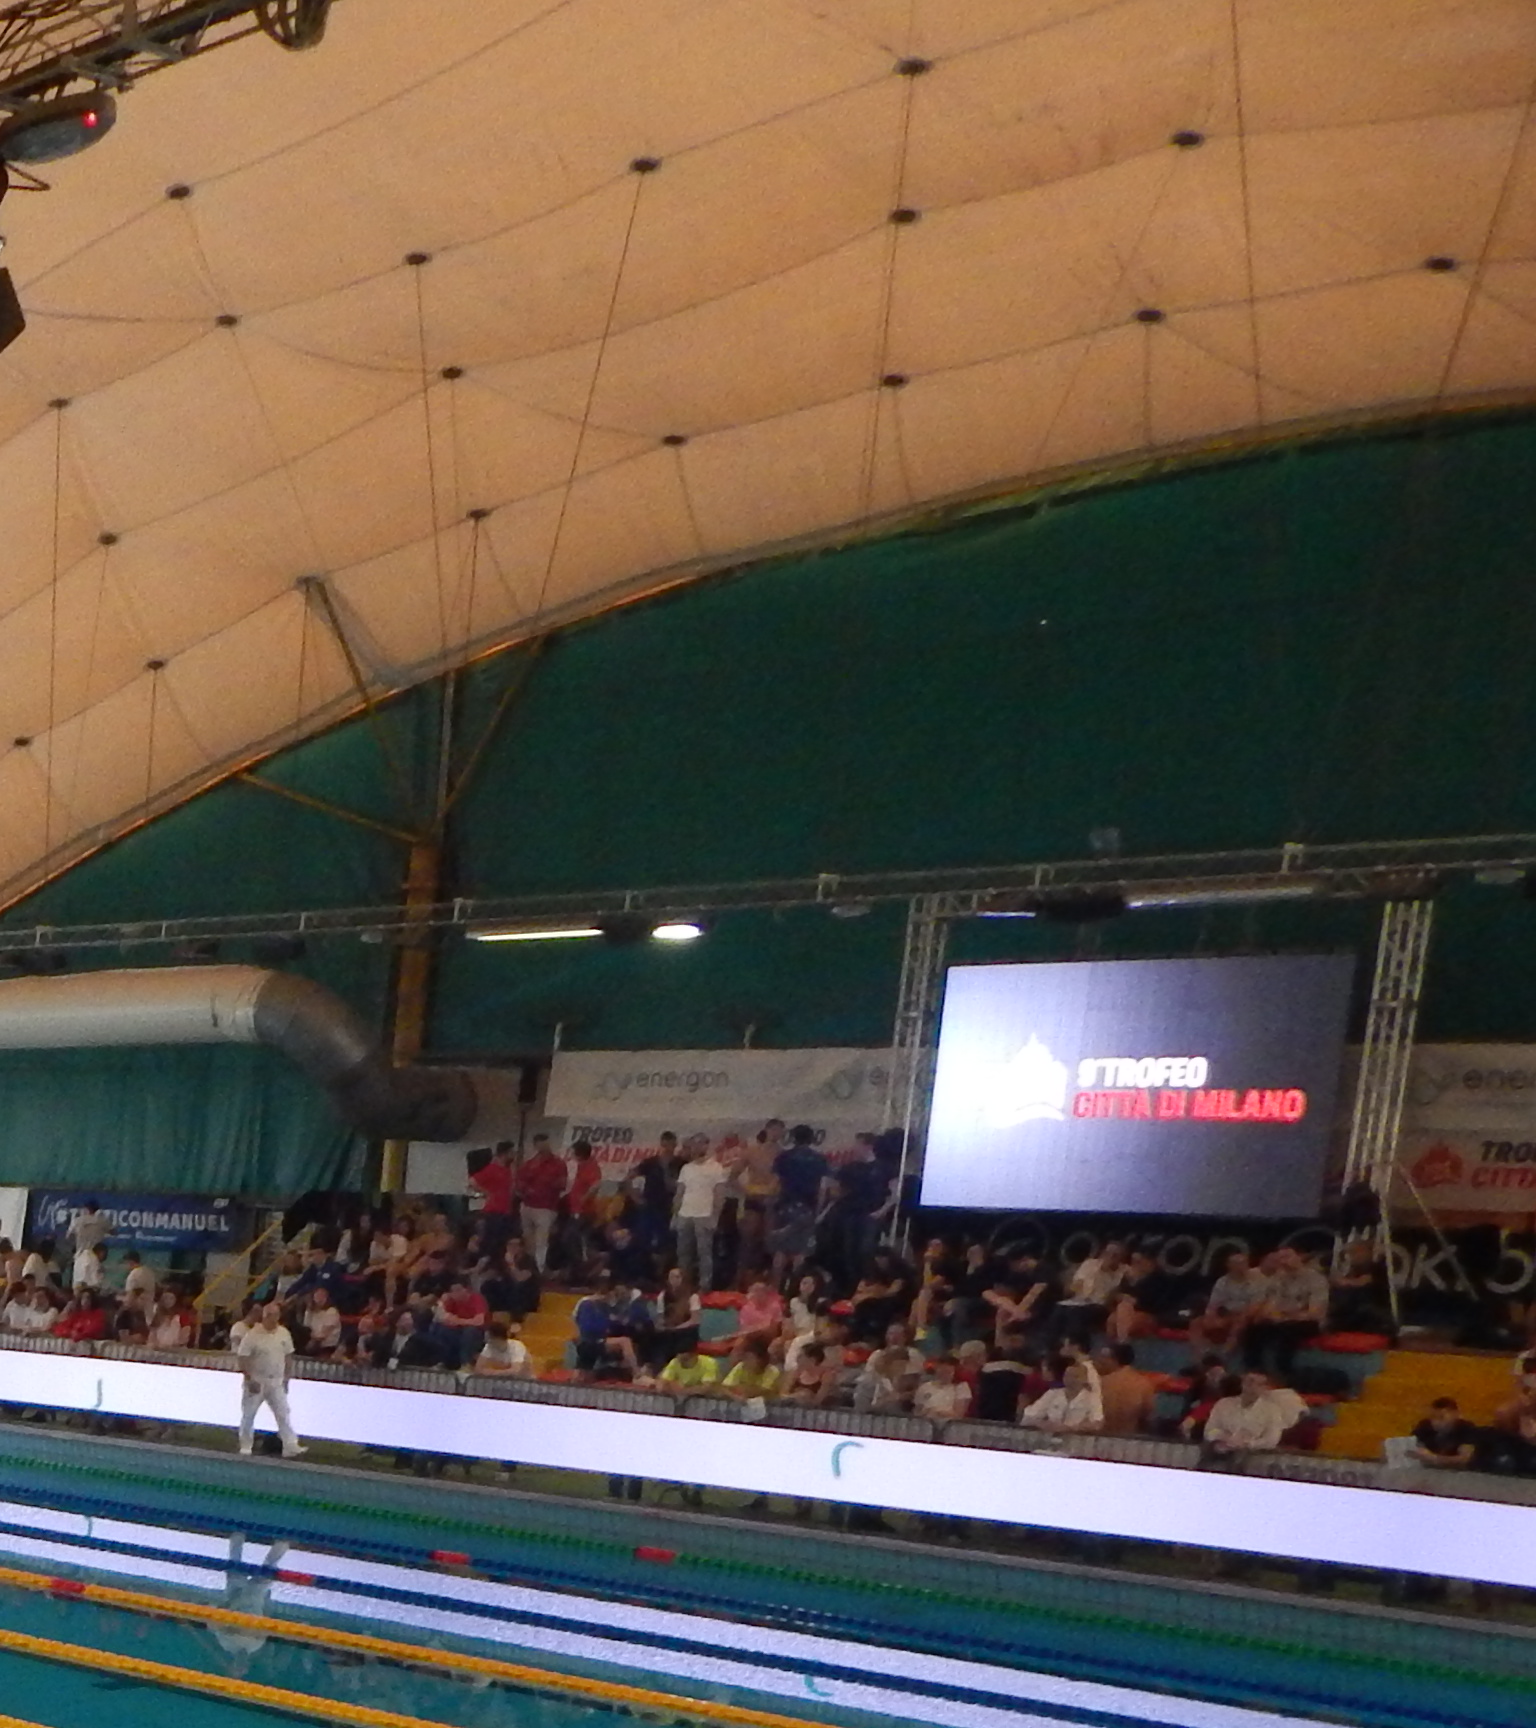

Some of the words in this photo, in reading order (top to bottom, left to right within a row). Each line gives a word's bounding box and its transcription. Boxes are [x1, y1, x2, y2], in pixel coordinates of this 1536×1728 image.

[635, 1068, 729, 1093] energon
[1155, 1088, 1188, 1120] DI
[1191, 1086, 1308, 1123] MILANO
